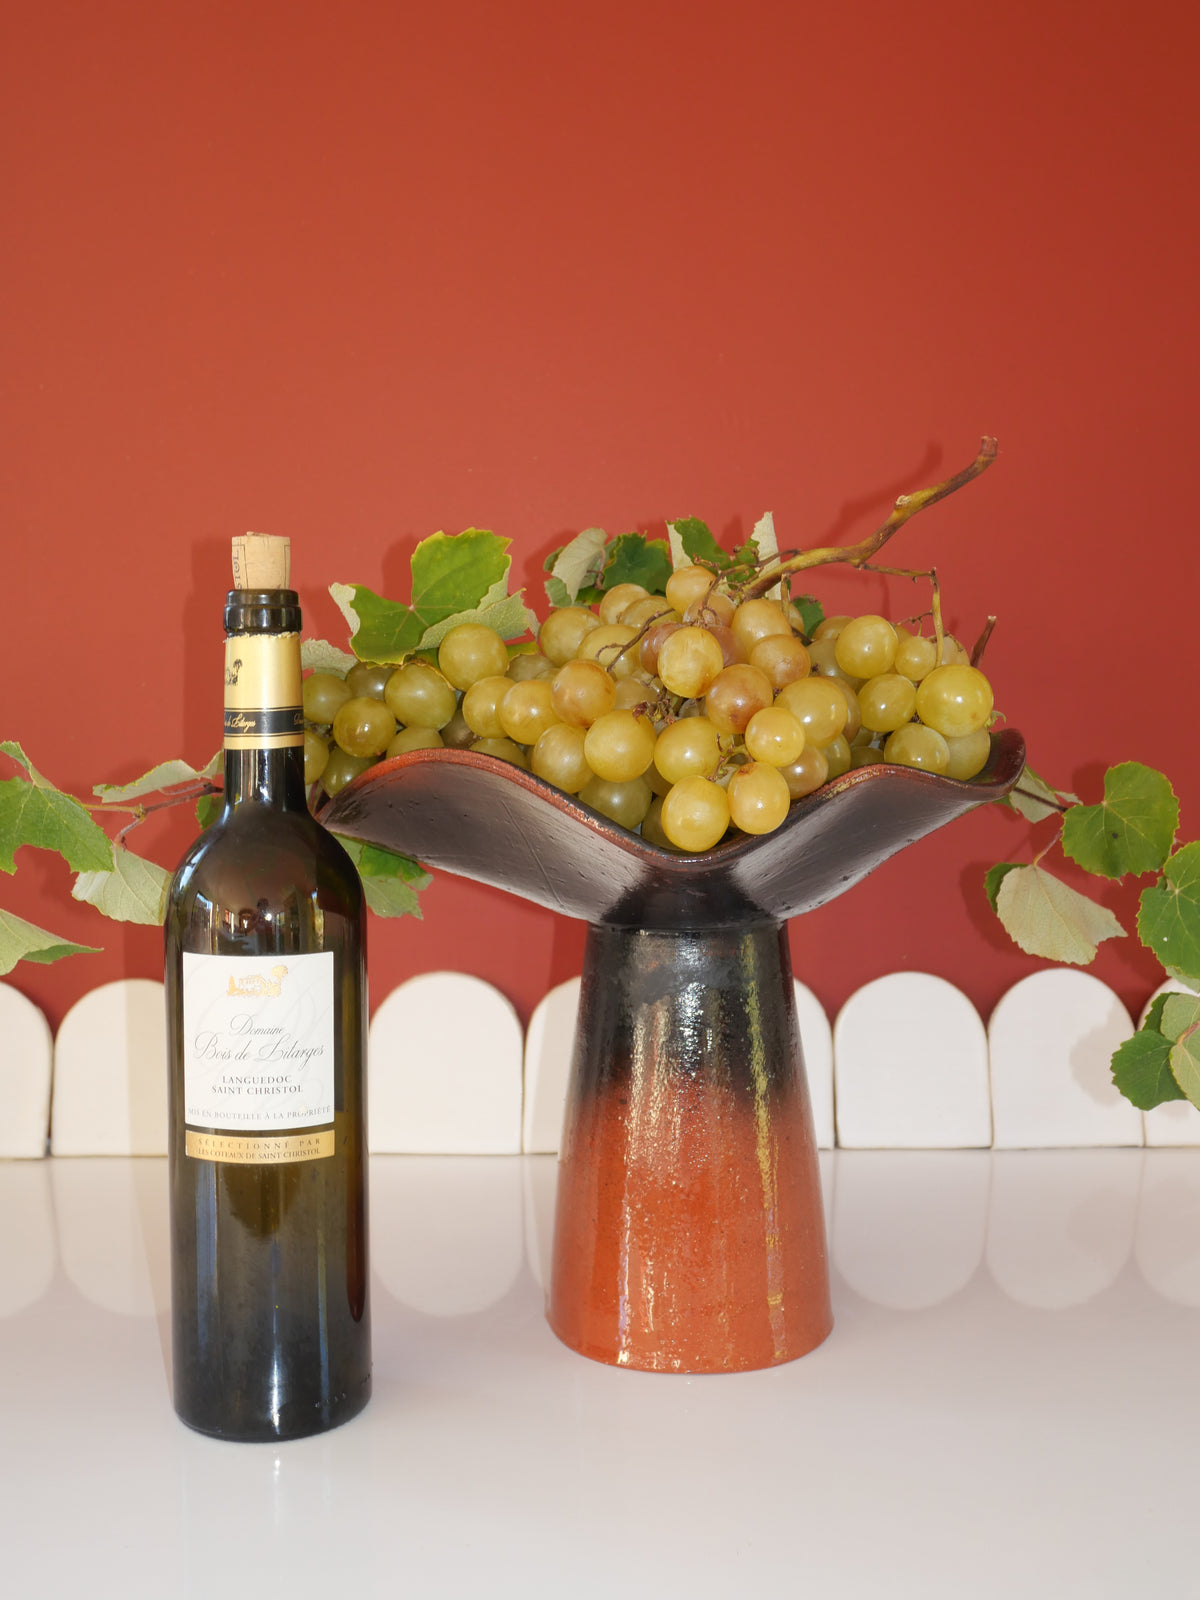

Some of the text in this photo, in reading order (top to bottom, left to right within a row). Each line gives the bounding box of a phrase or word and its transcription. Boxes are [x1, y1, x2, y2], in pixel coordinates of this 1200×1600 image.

[229, 1012, 285, 1036] Domaine
[194, 1031, 324, 1072] Bois de Lilarges
[221, 1074, 293, 1085] LANGUEDOC
[211, 1084, 304, 1096] SAINT CHRISTOL
[201, 1109, 212, 1119] EN
[214, 1111, 262, 1121] BOUTEILLE
[273, 1112, 285, 1121] LA
[299, 1137, 321, 1148] PAR
[197, 1147, 320, 1160] LES COTEAUX DE SAINT CHRISTOL
